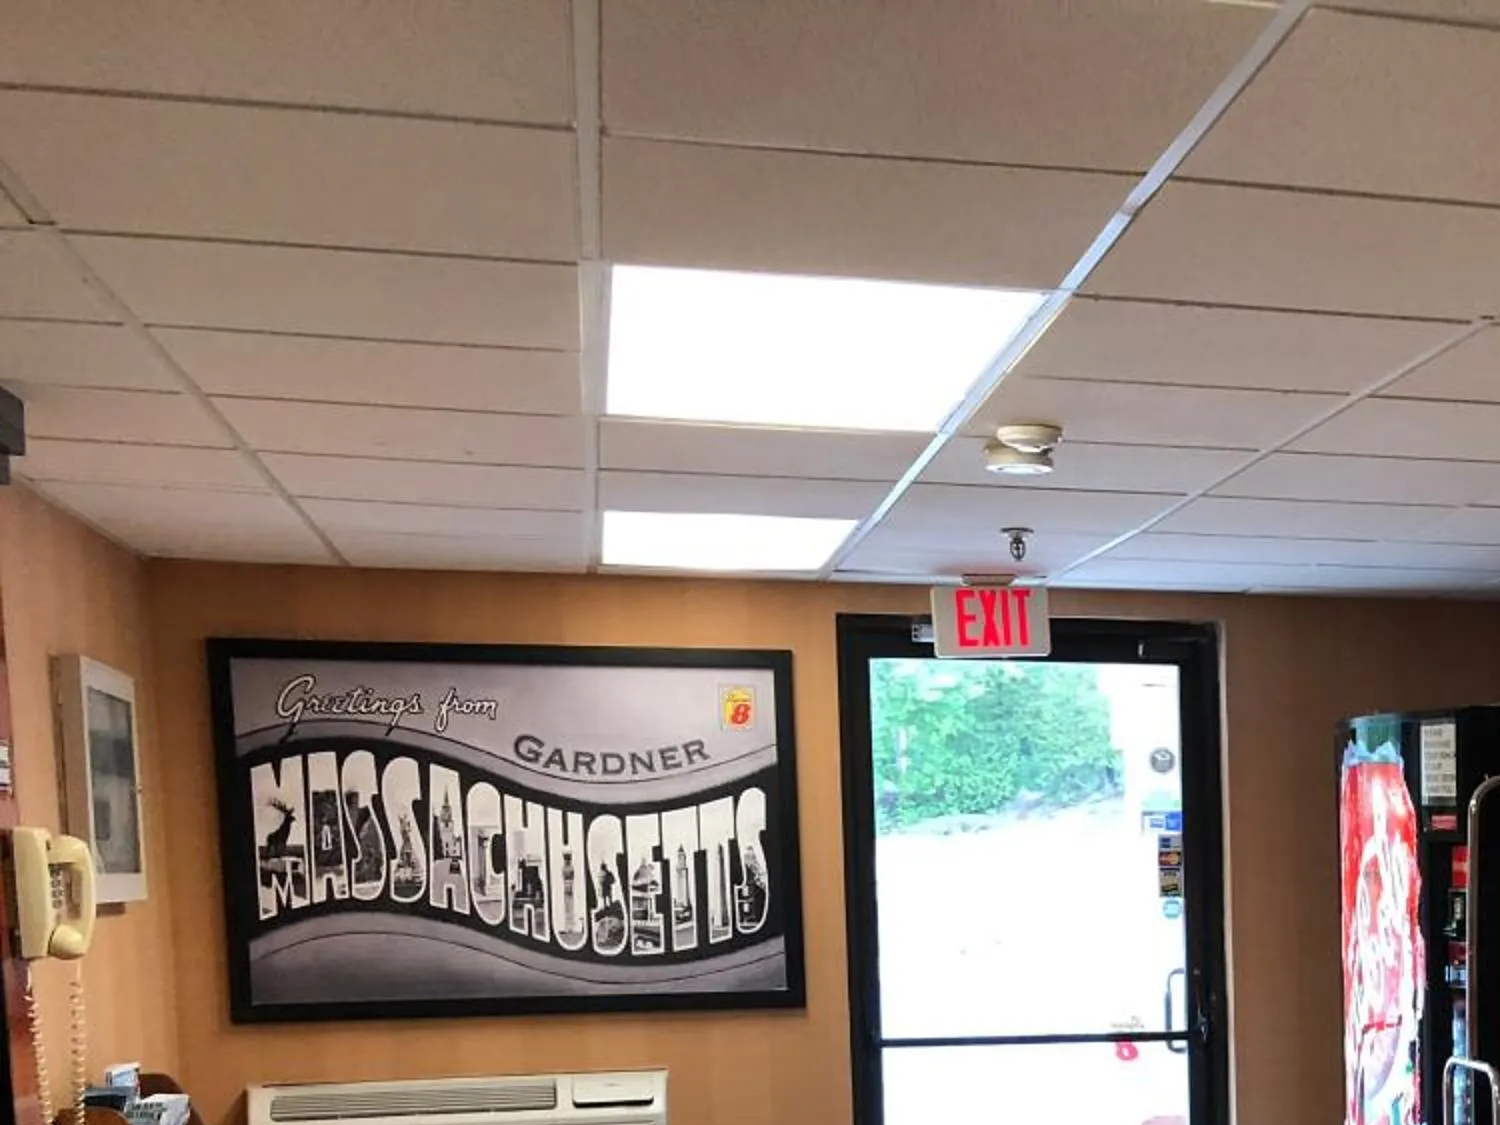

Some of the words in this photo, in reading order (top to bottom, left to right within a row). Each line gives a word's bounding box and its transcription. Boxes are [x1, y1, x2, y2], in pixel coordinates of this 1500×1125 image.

[955, 588, 1031, 648] EXIT
[277, 674, 423, 743] Greetings
[434, 687, 498, 733] from
[513, 733, 711, 776] GARDNER
[250, 750, 769, 956] MASSACHUSETTS
